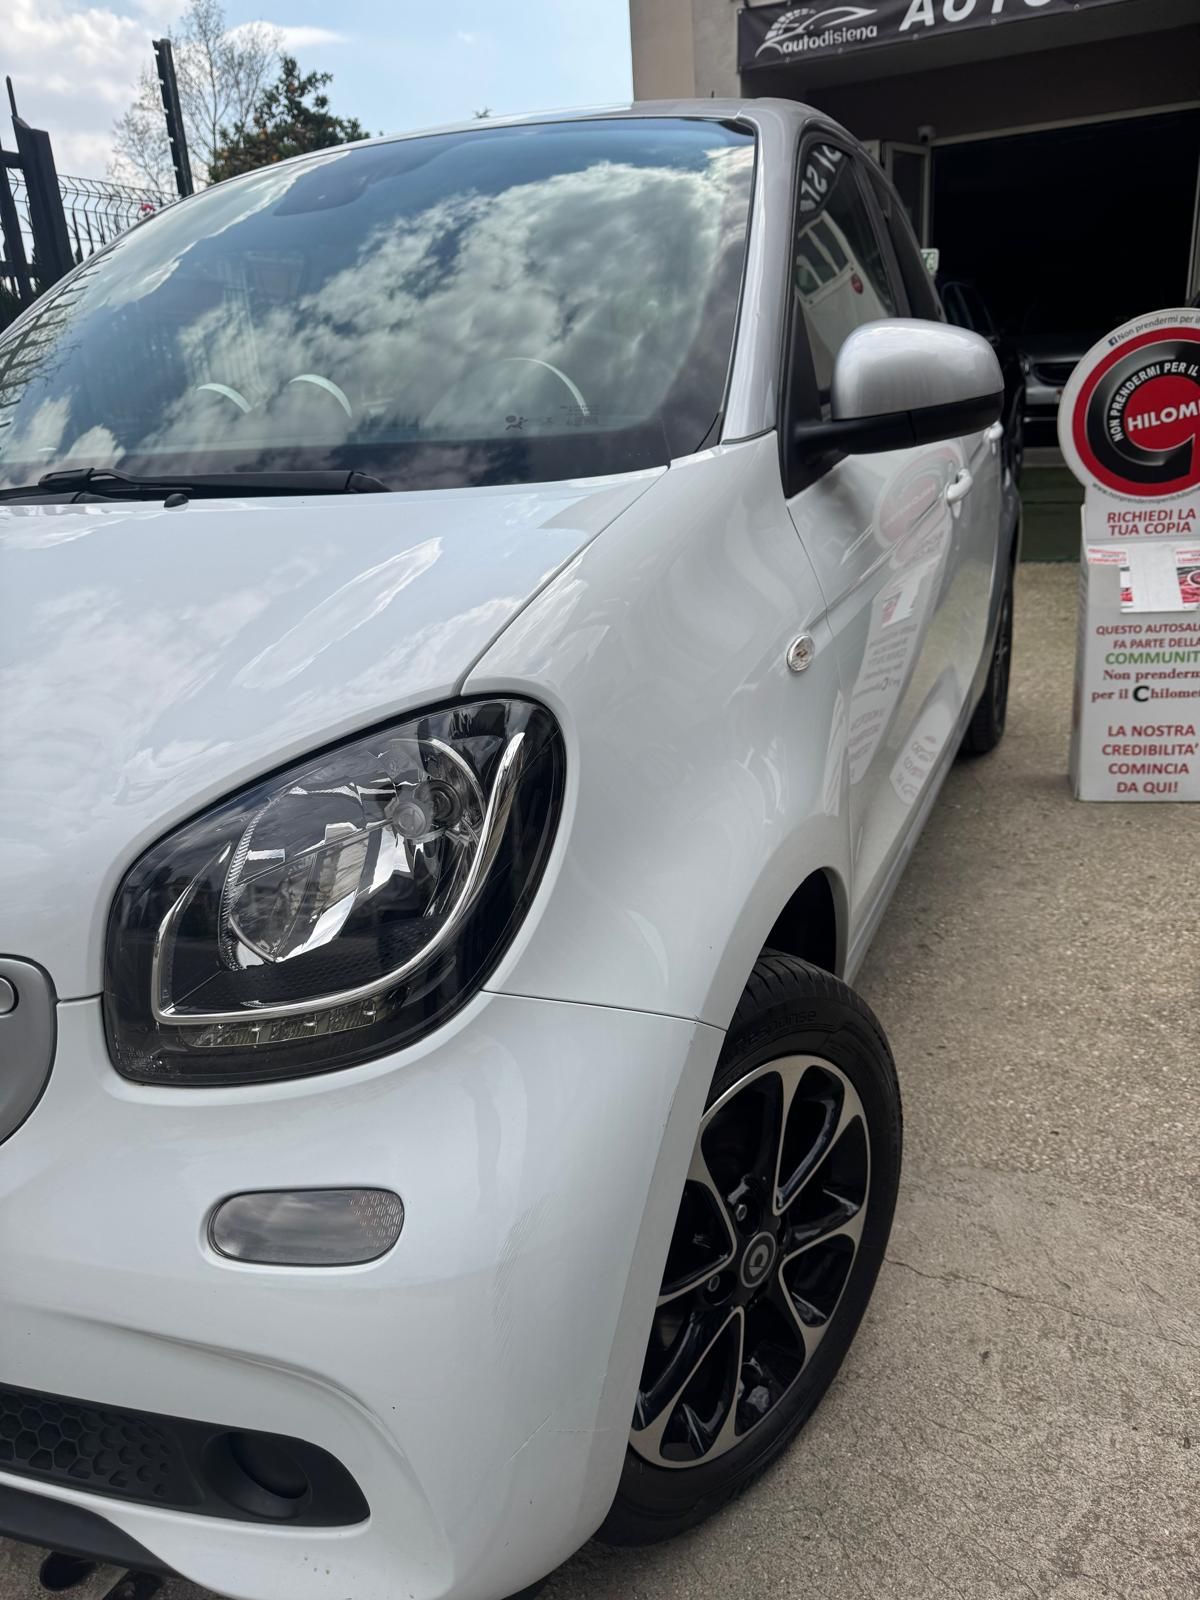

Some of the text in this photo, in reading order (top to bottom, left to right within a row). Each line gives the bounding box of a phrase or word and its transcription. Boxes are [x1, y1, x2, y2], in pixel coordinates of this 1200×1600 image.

[782, 24, 878, 54] autodisiena
[1117, 328, 1135, 341] Non
[1135, 314, 1179, 333] prendermi
[1179, 315, 1194, 325] per
[1109, 361, 1200, 442] NON PRENDERMI PER IL
[1127, 400, 1200, 432] HILOM
[1107, 508, 1196, 523] RICHEDI LA
[1108, 521, 1191, 536] TUA COPIA
[1096, 622, 1200, 636] QUESTO AUTOSAL
[1113, 639, 1127, 649] FA
[1130, 637, 1165, 649] PARTE
[1103, 669, 1131, 681] Non
[1091, 690, 1115, 703] per
[1118, 688, 1129, 700] il
[1107, 724, 1196, 737] LA NOSTRA
[1108, 762, 1190, 775] COMINCIA
[1116, 781, 1179, 795] DA QUI!
